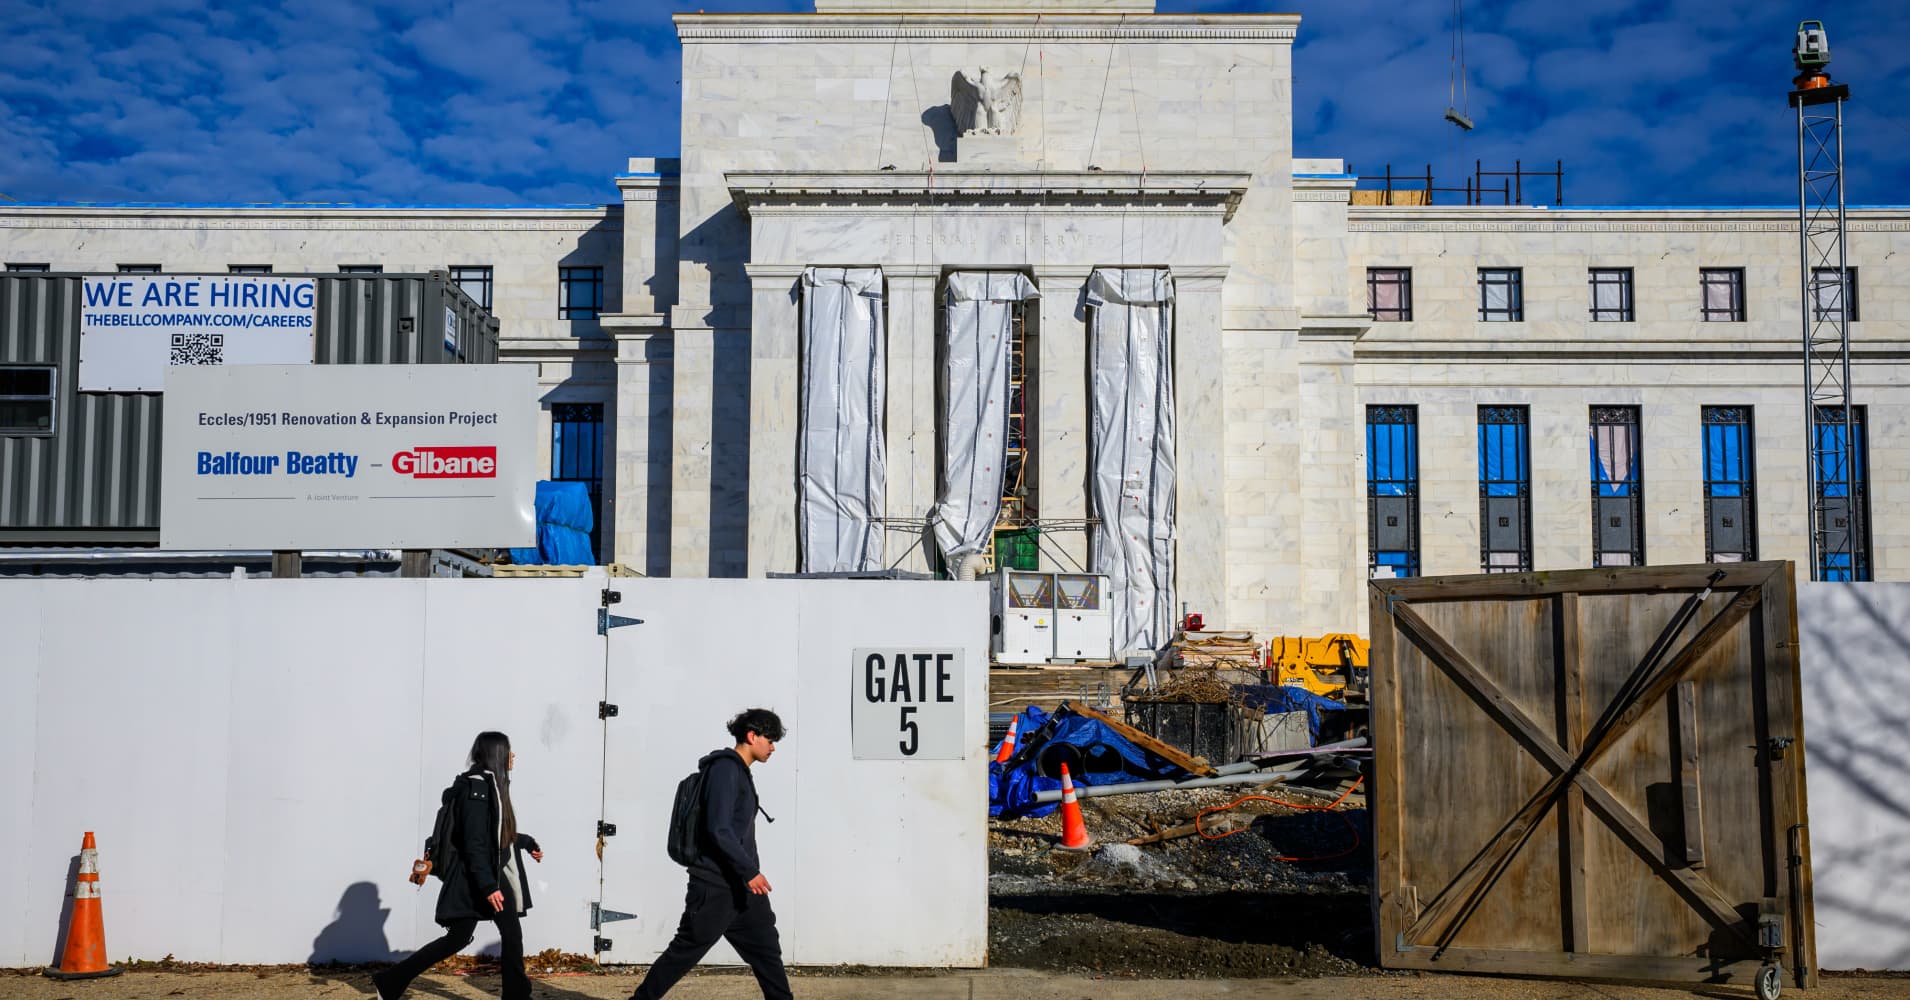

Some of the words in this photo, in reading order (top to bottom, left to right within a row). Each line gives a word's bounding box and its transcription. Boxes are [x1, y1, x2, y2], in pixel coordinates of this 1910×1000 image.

[84, 282, 133, 307] WE
[142, 282, 200, 307] ARE
[210, 283, 315, 308] HIRING
[85, 313, 313, 328] THEBELLCOMPANY.COM/CAREERS
[198, 412, 277, 427] Eccles/1951
[281, 412, 357, 426] Renovation
[361, 412, 371, 425] &
[375, 411, 445, 428] Expansion
[449, 411, 498, 427] Project
[197, 451, 279, 475] Balfour
[287, 451, 358, 478] Beatty
[392, 447, 495, 475] Gilbane
[865, 653, 954, 704] GATE
[899, 706, 919, 756] 5
